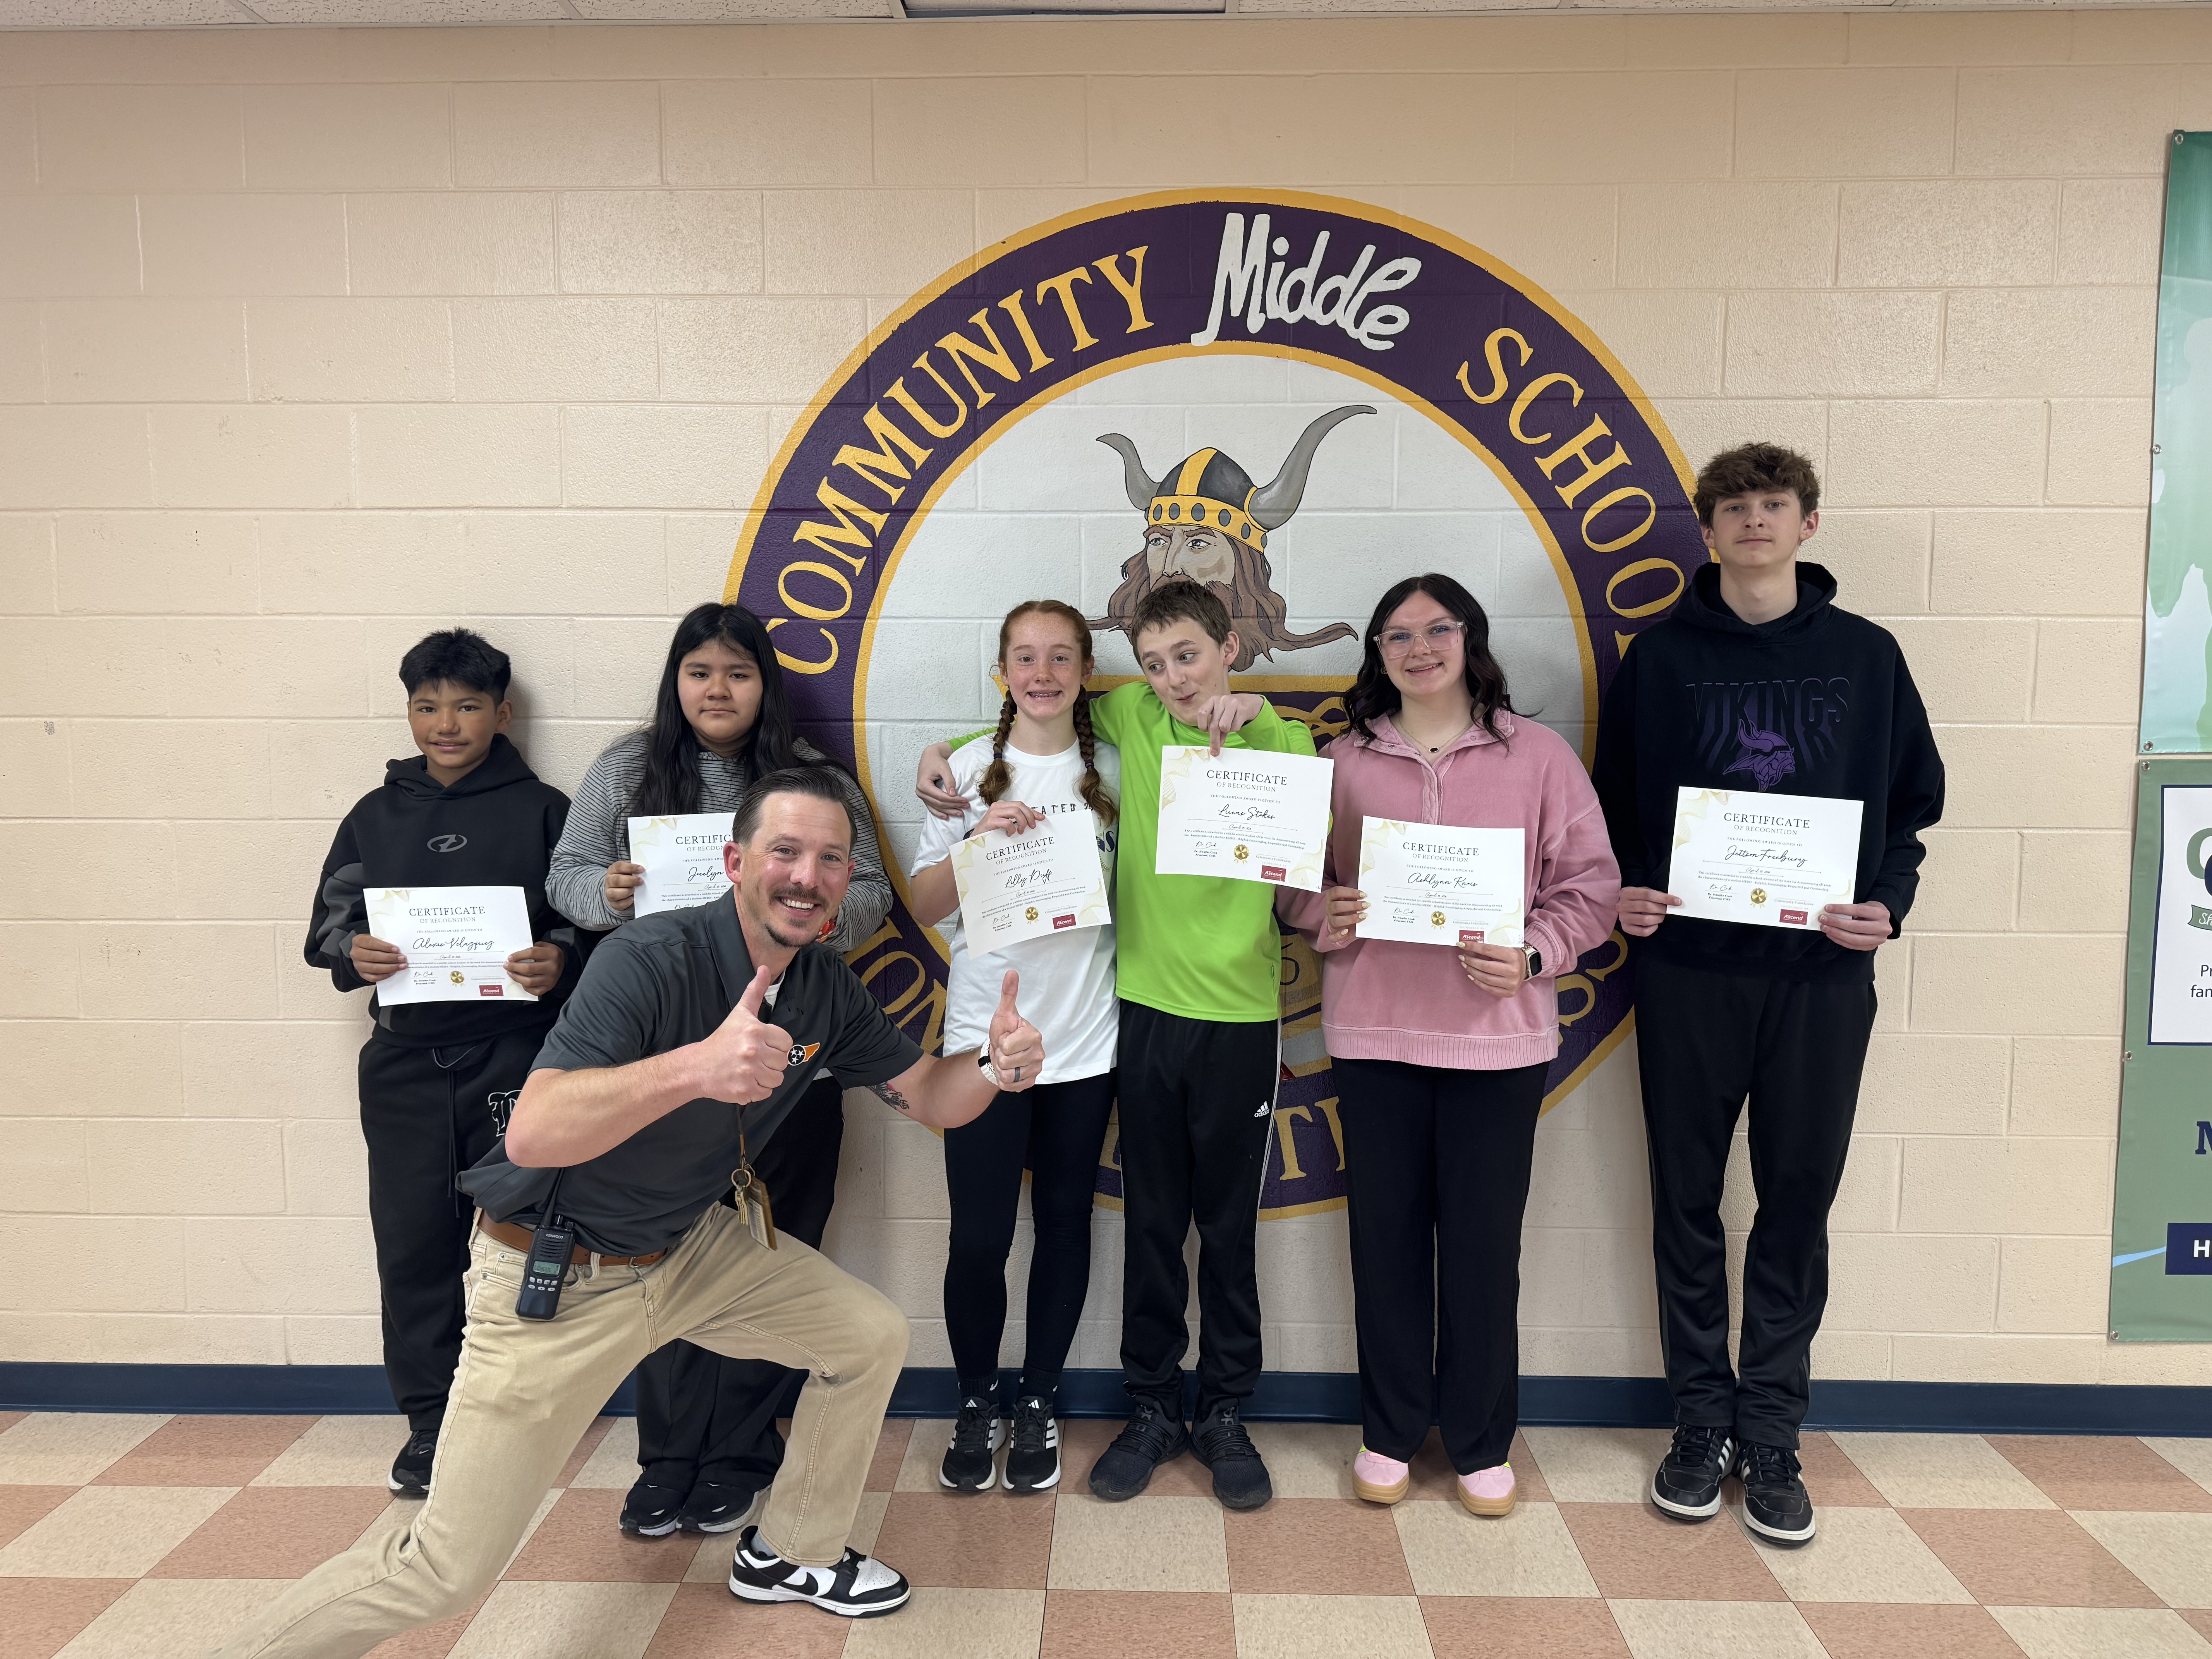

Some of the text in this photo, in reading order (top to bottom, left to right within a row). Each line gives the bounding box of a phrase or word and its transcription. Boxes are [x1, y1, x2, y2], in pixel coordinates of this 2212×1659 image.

[767, 212, 1685, 675] COMMUNITY Middle SCHOO
[1686, 676, 1851, 726] VIKINGS
[1207, 770, 1287, 785] CERTIFICATE
[1228, 782, 1275, 792] RECOGNITION
[1724, 813, 1810, 828] CERTIFICATE
[1746, 826, 1797, 835] RECOGNITION
[676, 834, 731, 845] CERTIFIC
[986, 836, 1054, 860] CERTIFICATE
[1005, 848, 1046, 862] RECOGNITION
[1403, 842, 1479, 855] CERTIFICATE
[688, 866, 724, 882] Jocelyn
[1004, 873, 1027, 888] Lilly
[1408, 872, 1452, 888] Ashlynn
[409, 906, 485, 916] CERTIFICATE
[445, 936, 495, 951] Velazquez
